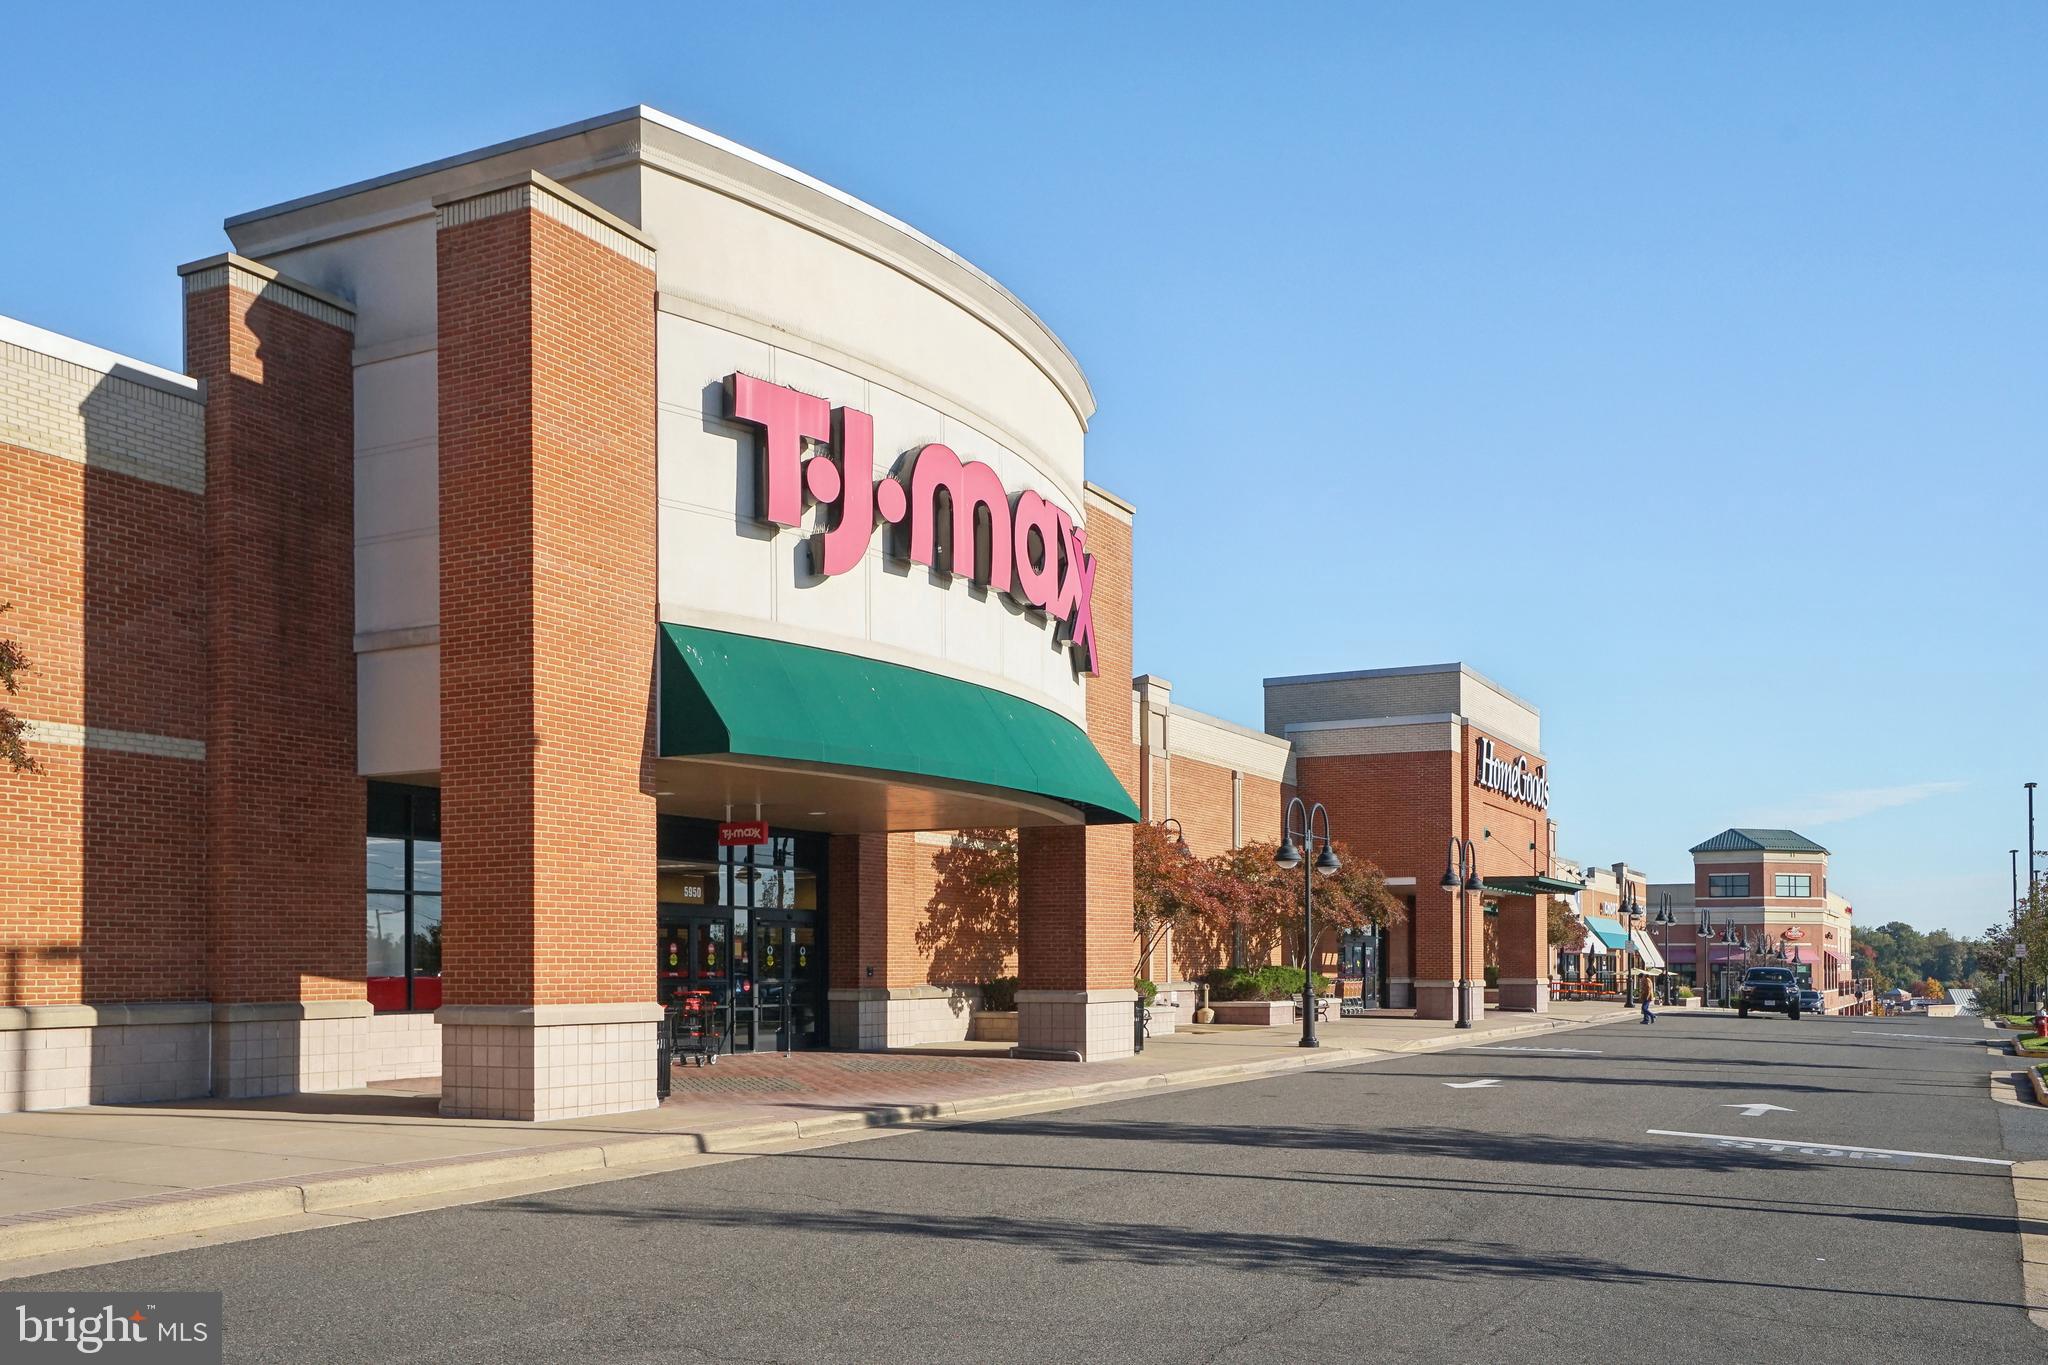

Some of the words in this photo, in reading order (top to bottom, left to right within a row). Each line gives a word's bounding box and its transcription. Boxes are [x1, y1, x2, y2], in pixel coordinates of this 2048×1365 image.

[1480, 737, 1550, 810] HomeGoods
[683, 886, 702, 898] 5950
[1717, 1139, 1893, 1160] STOP
